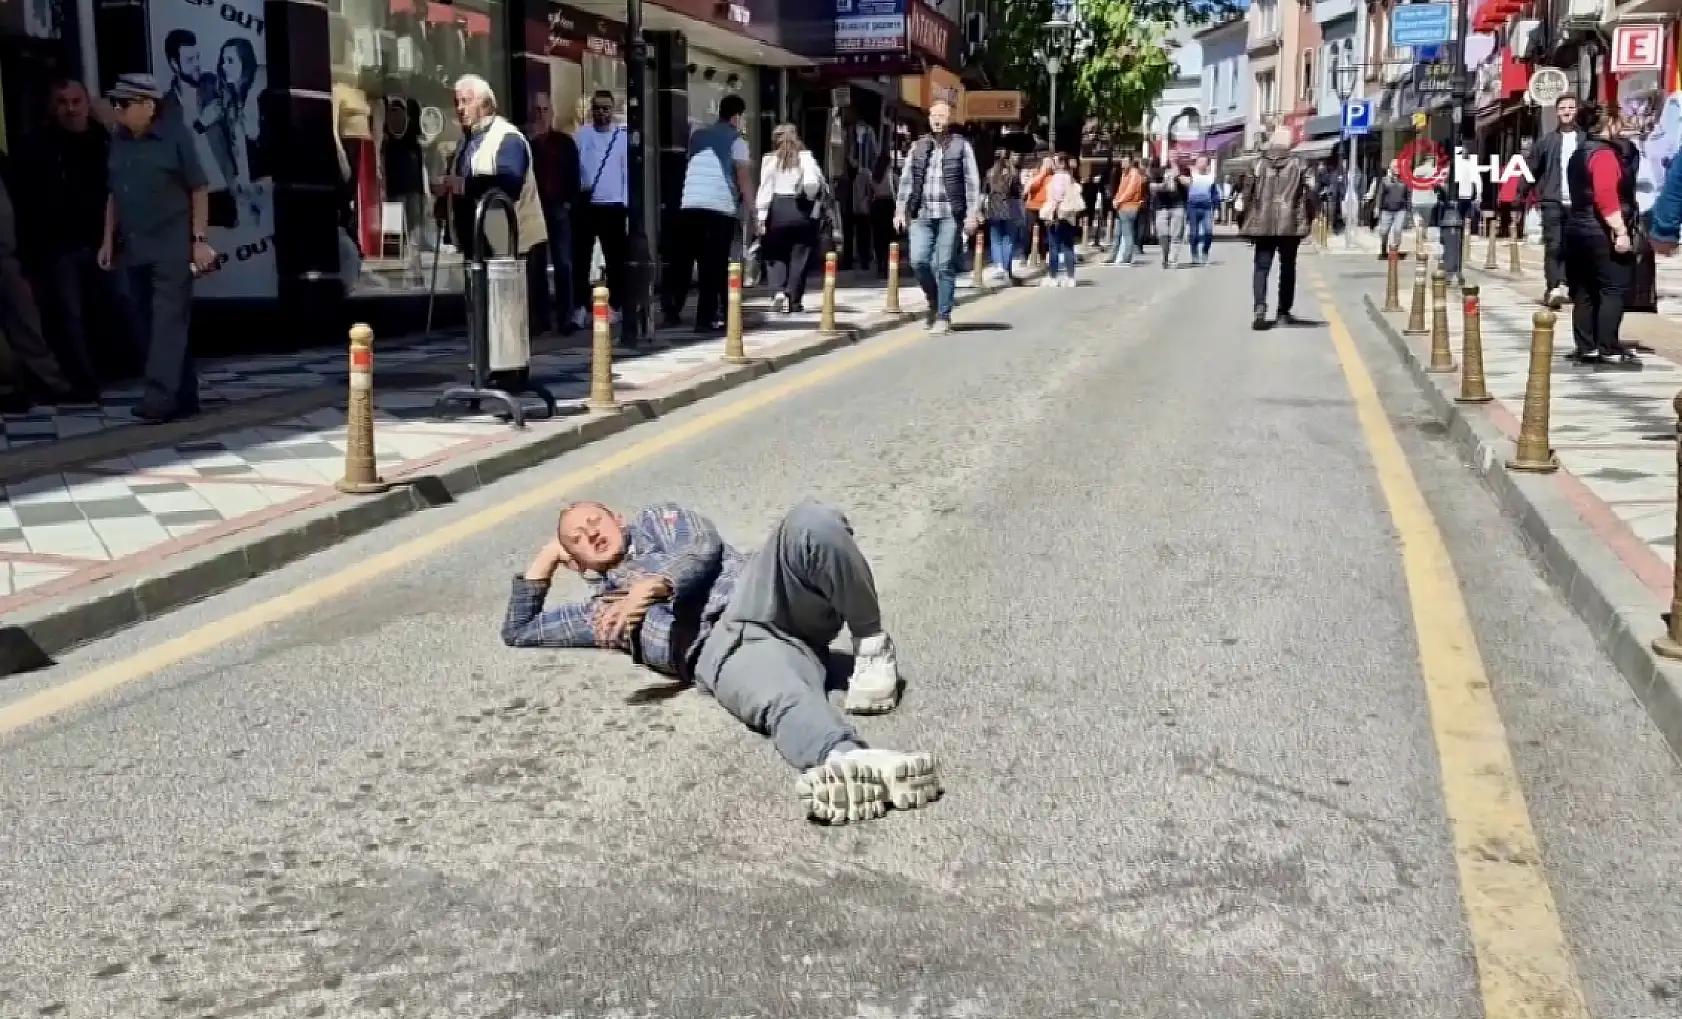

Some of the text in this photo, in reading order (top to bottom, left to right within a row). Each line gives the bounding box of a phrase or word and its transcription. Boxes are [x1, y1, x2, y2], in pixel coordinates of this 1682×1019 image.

[220, 3, 264, 36] OUT
[1629, 33, 1649, 60] E
[1347, 105, 1364, 127] P
